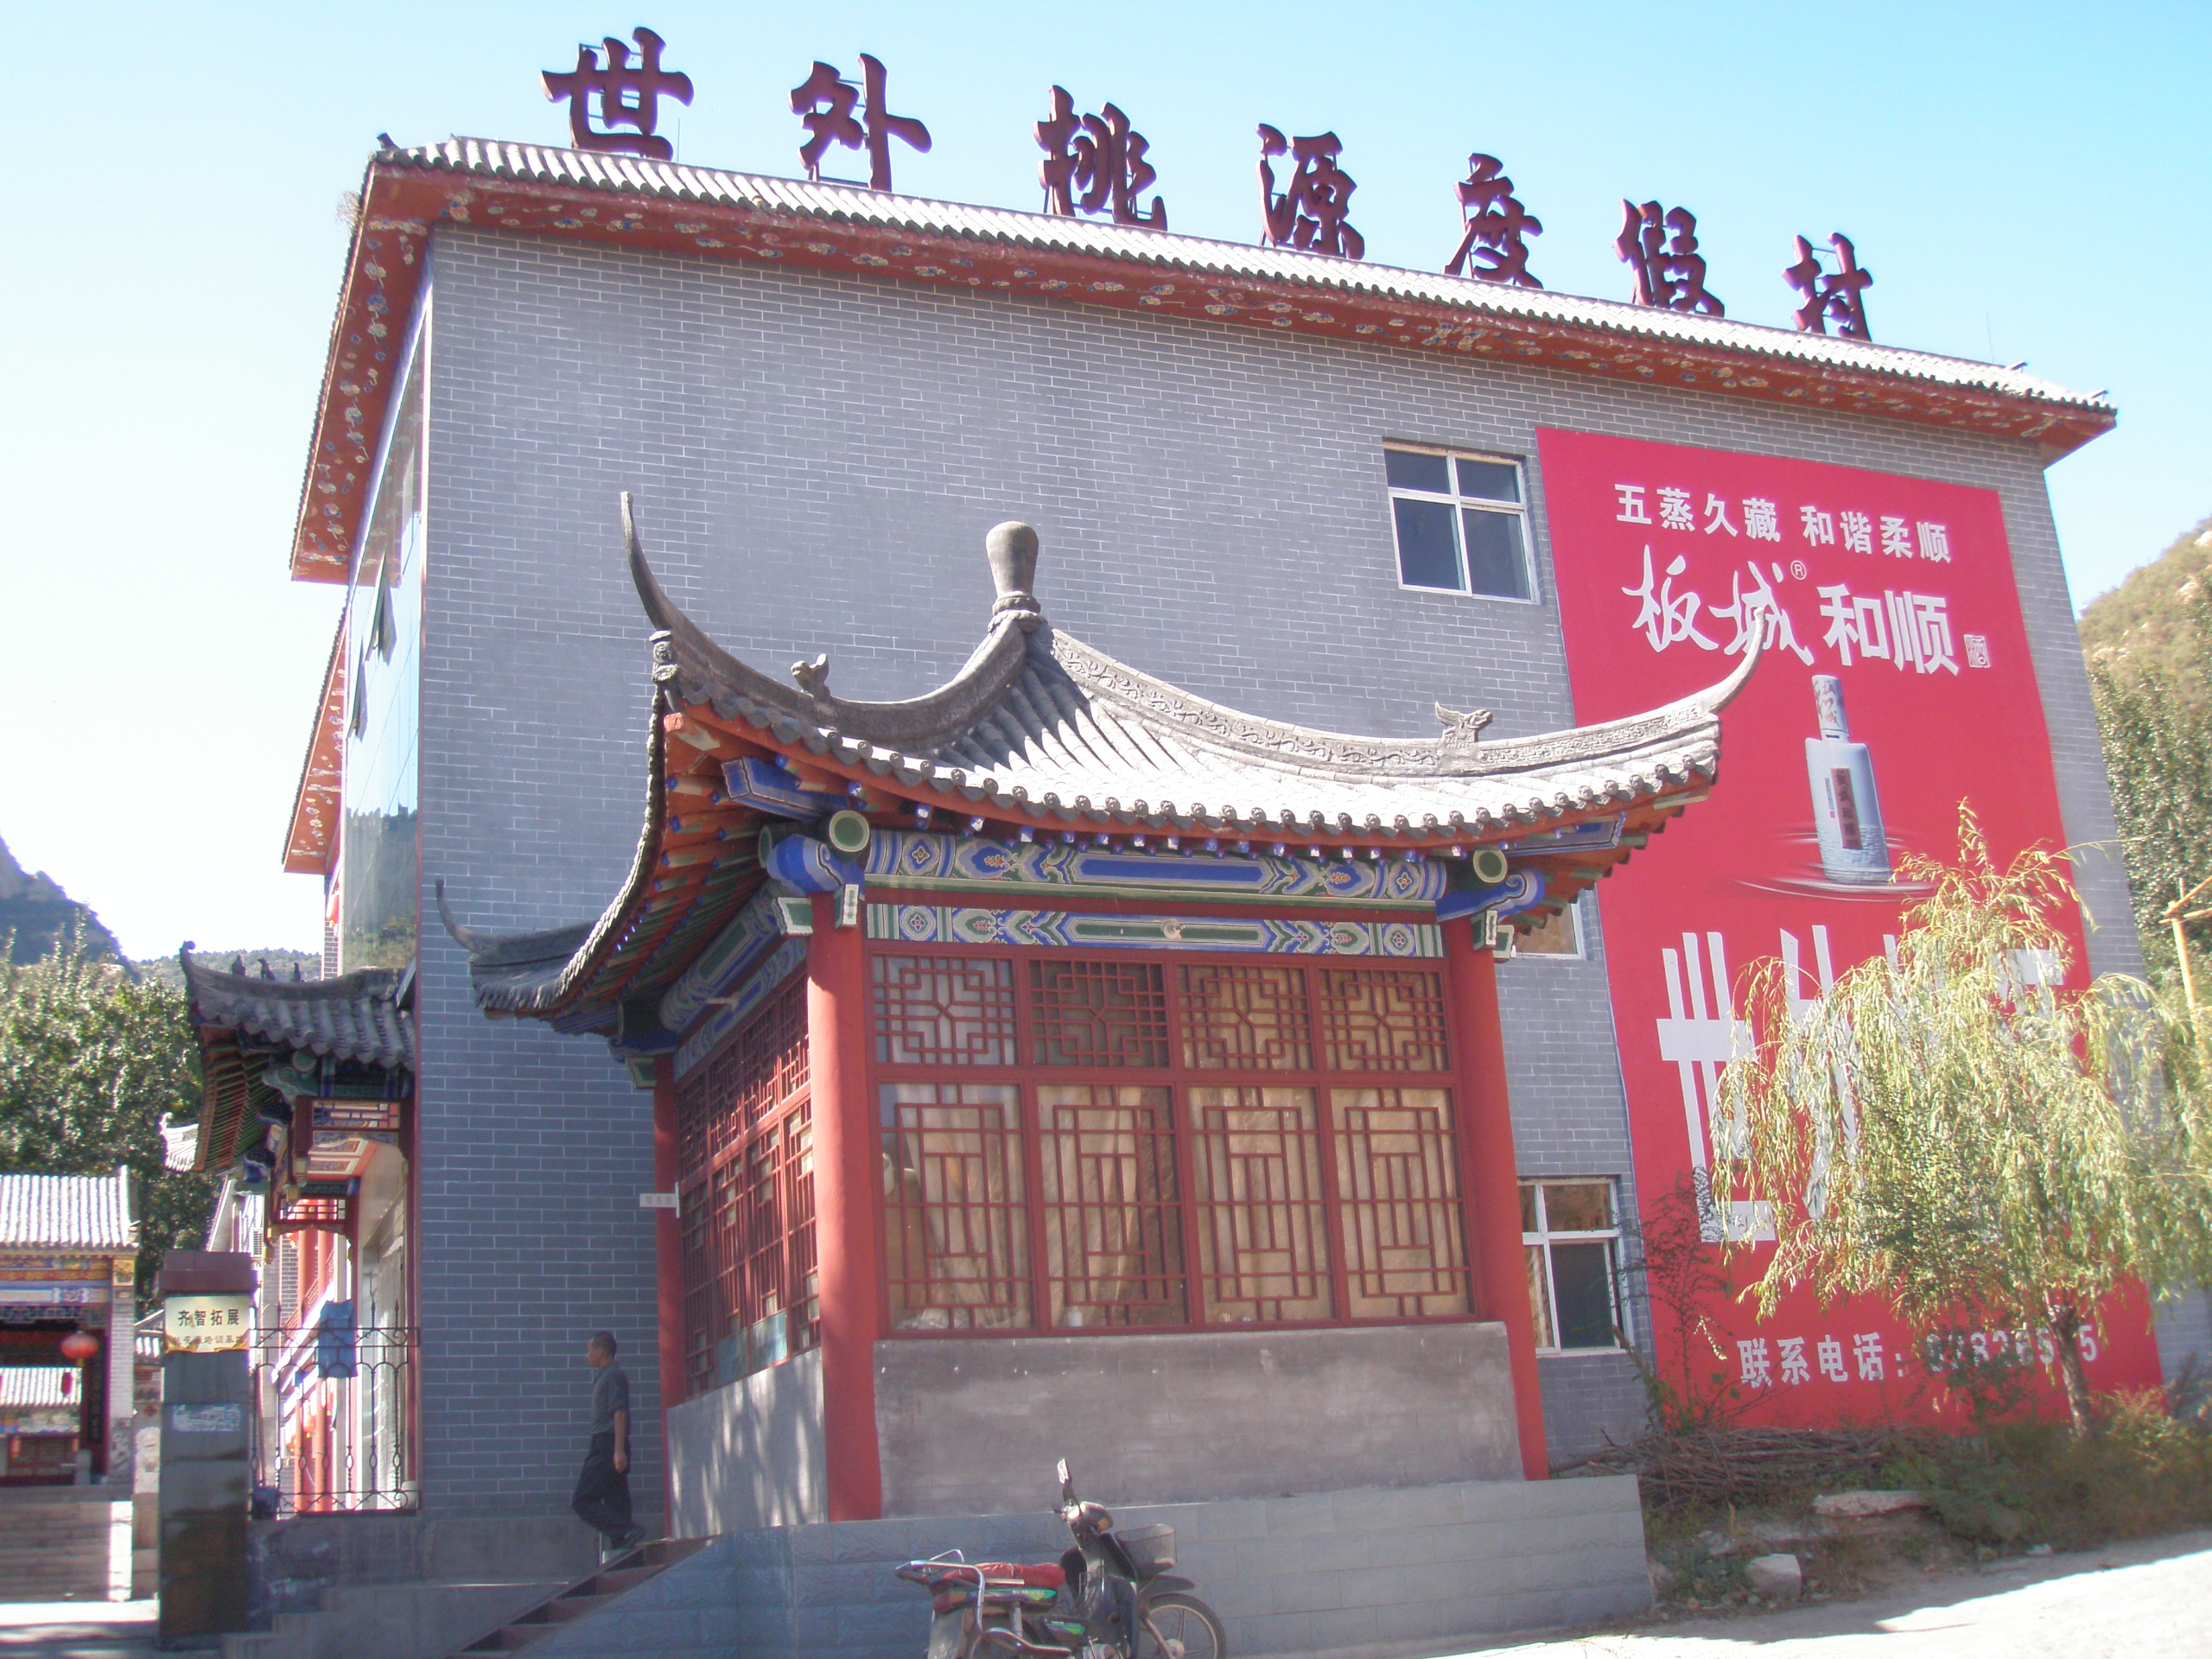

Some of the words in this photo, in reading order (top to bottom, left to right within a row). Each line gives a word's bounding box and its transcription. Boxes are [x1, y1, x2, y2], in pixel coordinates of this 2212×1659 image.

[1614, 484, 1781, 543] 五蒸久藏
[1799, 505, 1952, 564] 和谐柔顺
[178, 1309, 240, 1327] 齐智拓展
